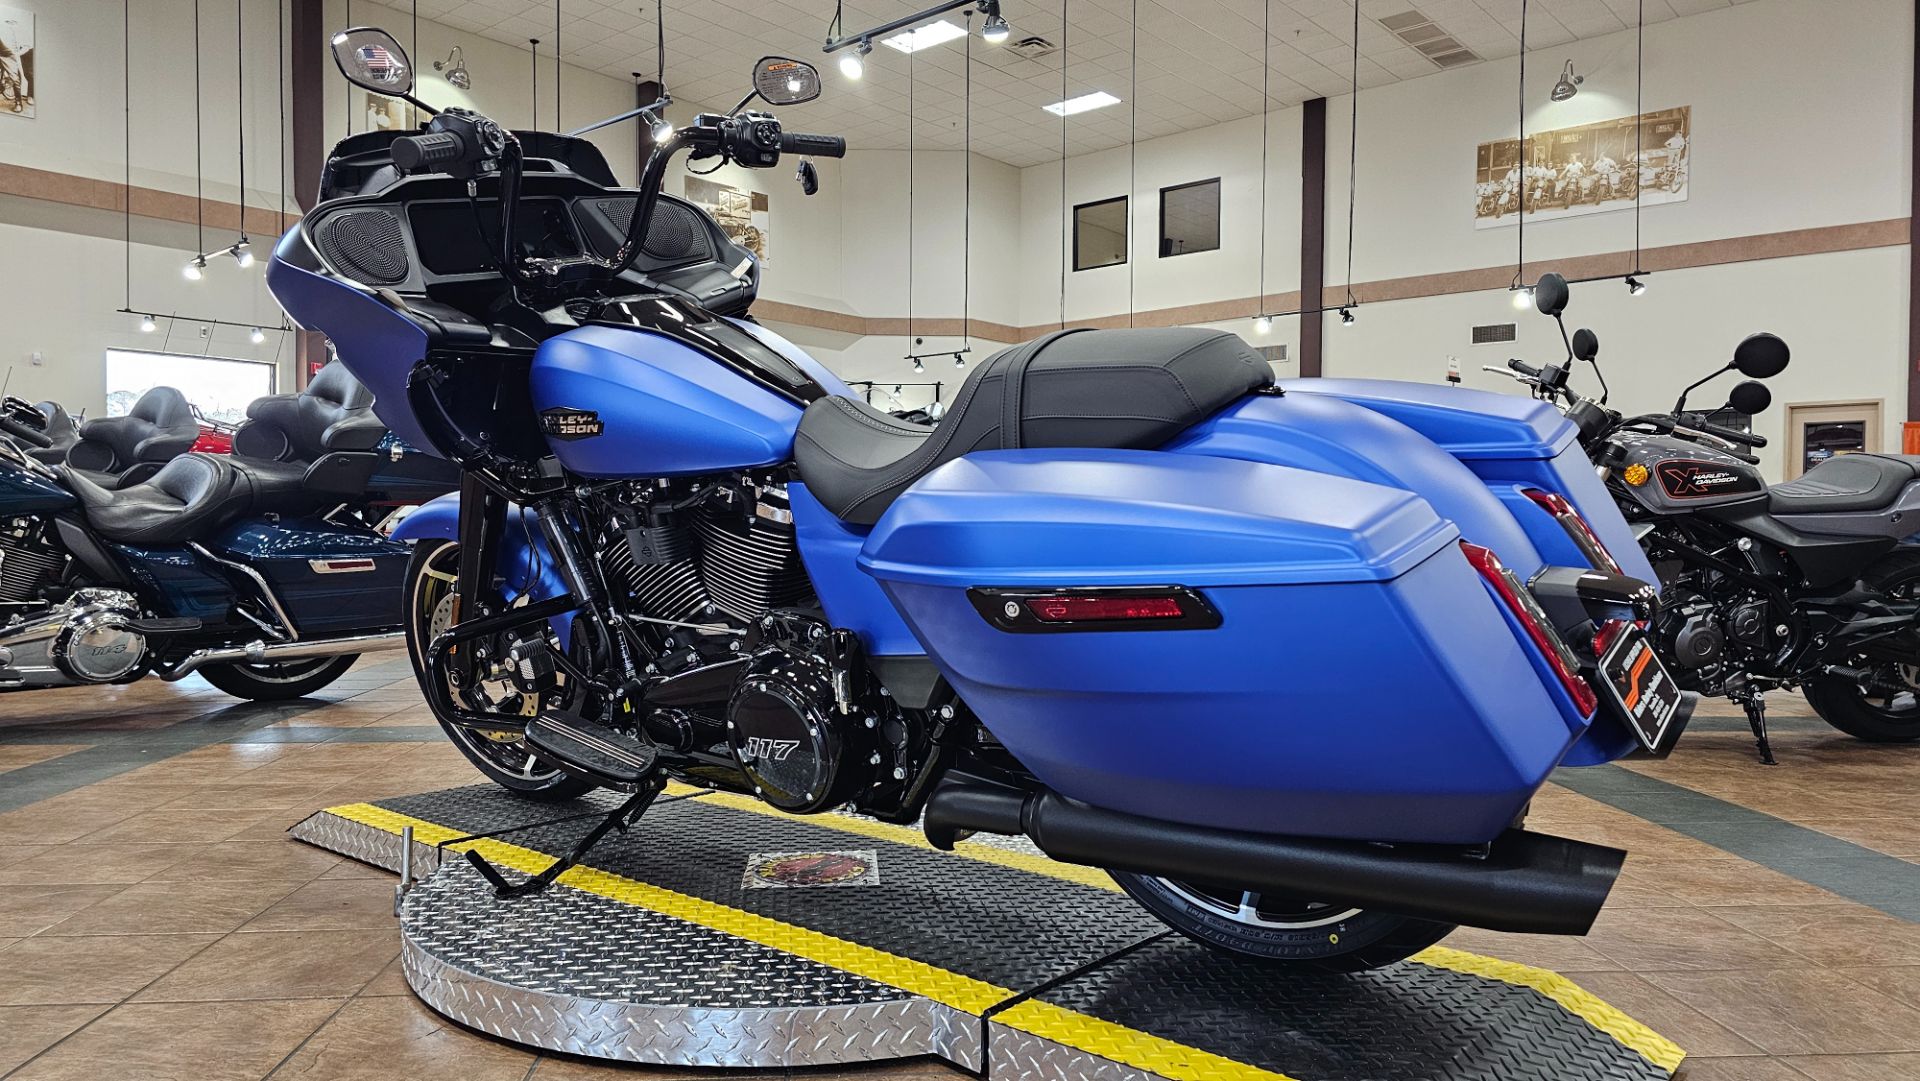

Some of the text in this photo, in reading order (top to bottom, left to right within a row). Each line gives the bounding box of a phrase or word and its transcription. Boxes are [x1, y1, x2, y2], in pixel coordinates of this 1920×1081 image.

[1692, 472, 1730, 480] HARLEY-
[1695, 476, 1738, 485] DAVIDSON
[748, 737, 800, 760] 117
